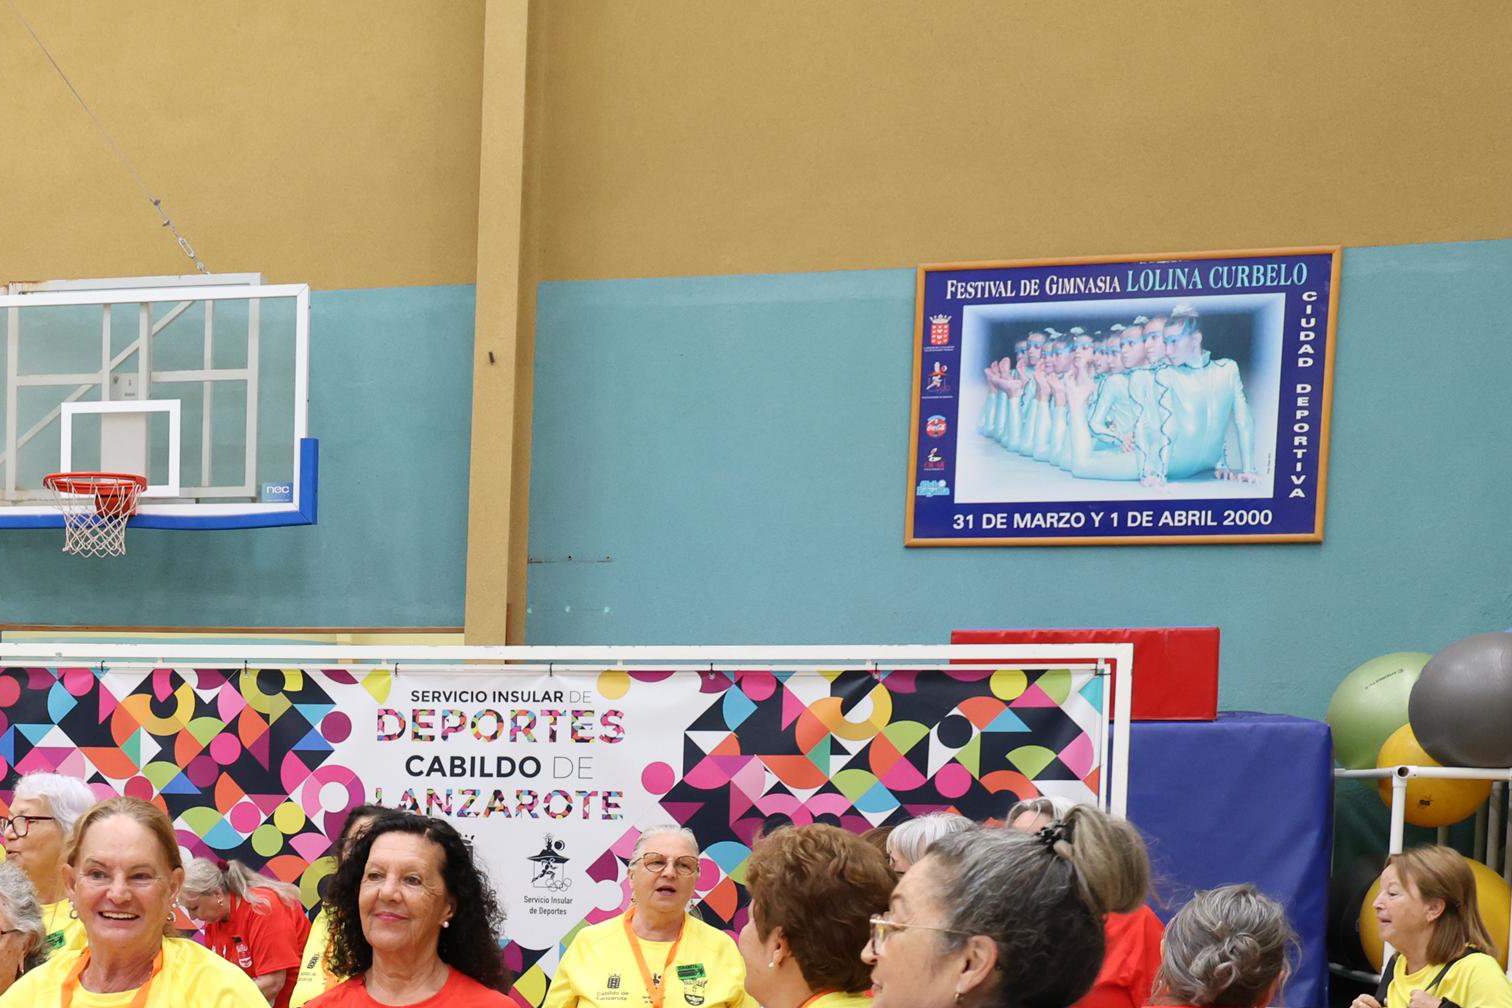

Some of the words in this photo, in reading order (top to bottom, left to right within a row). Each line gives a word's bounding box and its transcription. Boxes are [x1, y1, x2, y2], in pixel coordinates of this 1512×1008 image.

[945, 279, 1016, 300] FESTIVAL
[1019, 278, 1040, 297] DE
[1045, 275, 1121, 295] GIMNASIA
[1126, 267, 1203, 292] LOLINA
[1208, 262, 1308, 289] CURBELO
[1296, 291, 1317, 368] CIUDAD
[1288, 383, 1312, 498] DEPORTIVA
[953, 514, 974, 529] 31
[981, 513, 1007, 529] DE
[1013, 512, 1085, 529] MARZO
[1090, 512, 1107, 528] Y
[1110, 512, 1118, 527] 1
[1127, 511, 1152, 528] DE
[1159, 510, 1218, 527] ABRIL
[1223, 509, 1273, 526] 2000
[411, 690, 487, 703] SERVICIO
[492, 690, 564, 703] INSULAR
[569, 690, 592, 703] DE
[376, 708, 626, 744] DEPORTES
[405, 754, 541, 778] CABILDO
[552, 756, 594, 779] DE
[523, 895, 550, 904] Servicio
[551, 896, 573, 904] Insular
[529, 907, 538, 915] de
[538, 906, 567, 917] Deportes
